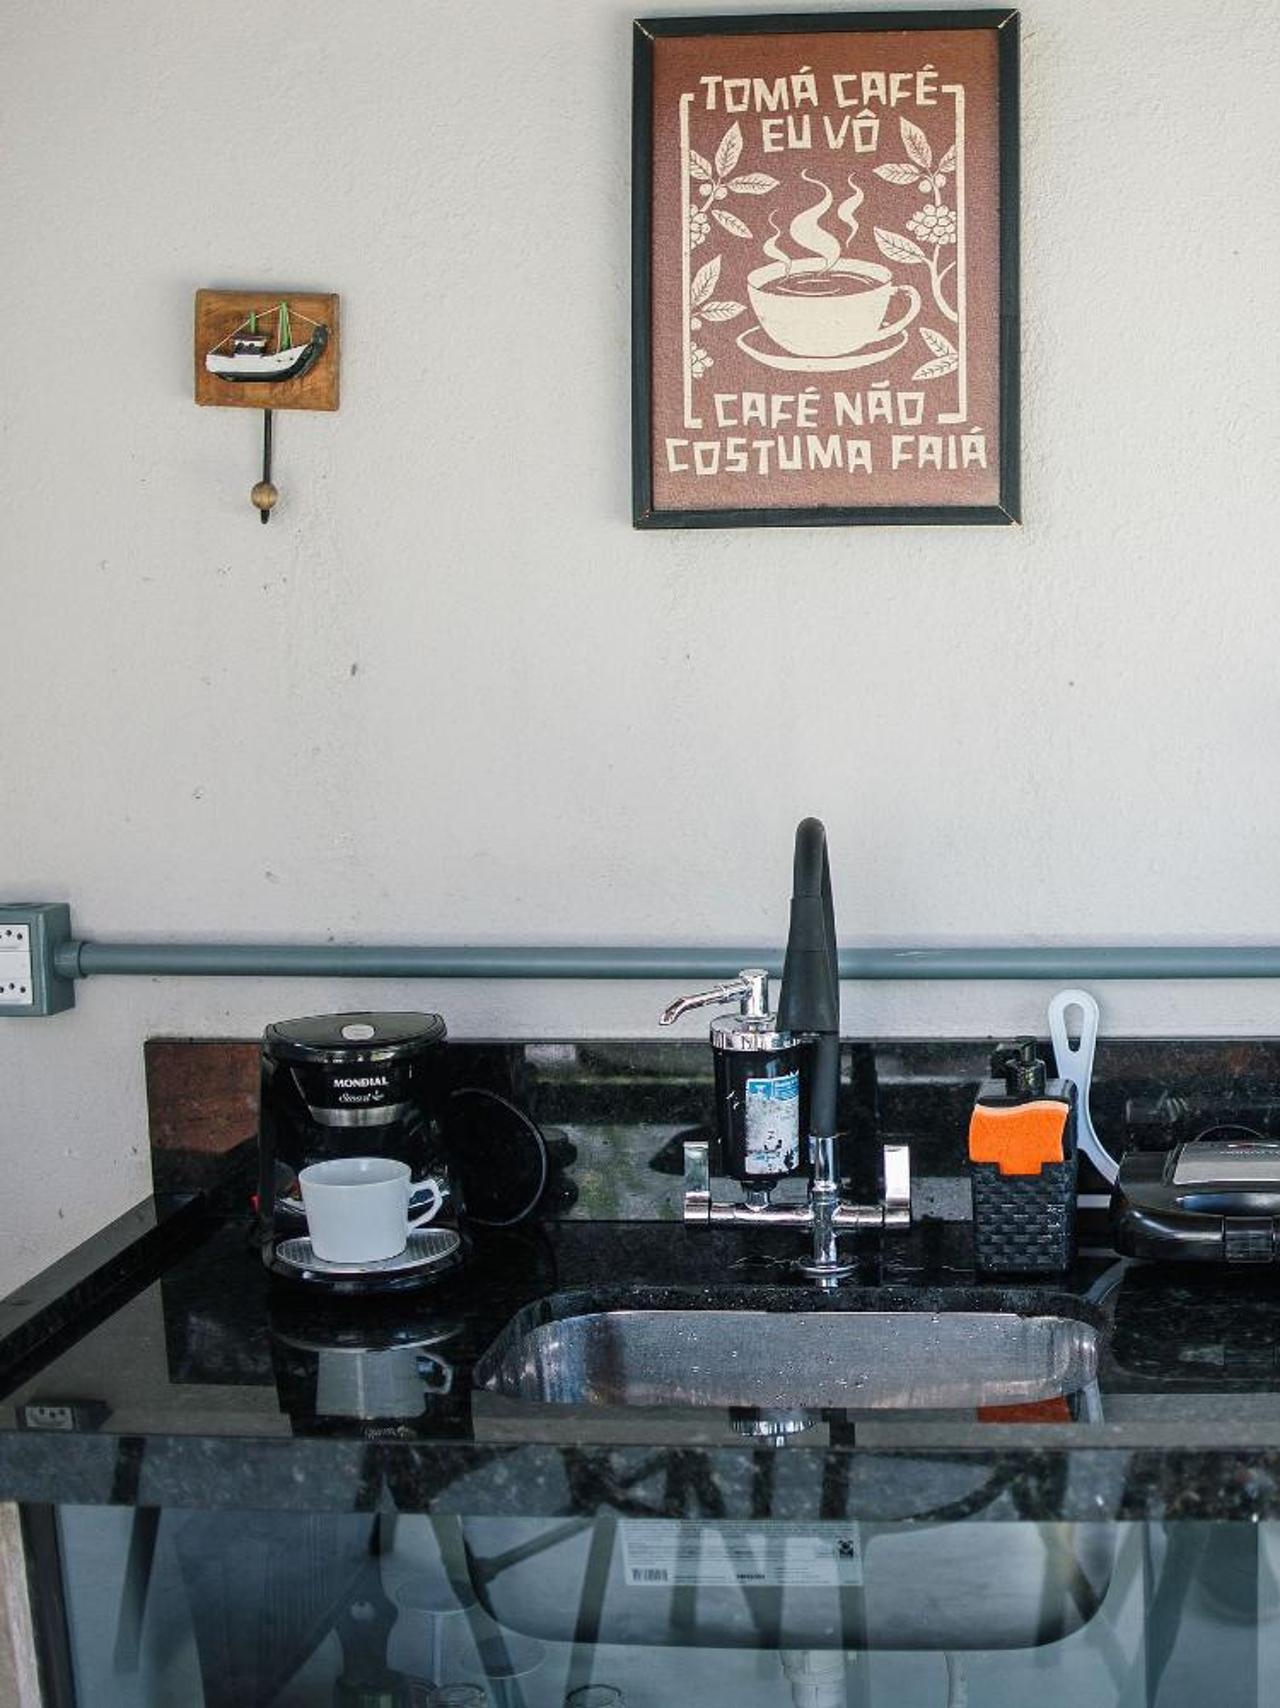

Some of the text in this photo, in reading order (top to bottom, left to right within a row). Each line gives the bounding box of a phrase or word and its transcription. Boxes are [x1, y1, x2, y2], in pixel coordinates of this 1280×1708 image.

[700, 64, 938, 113] TOMÁ CAFÉ
[761, 109, 880, 153] EU VÔ
[714, 380, 926, 429] CAFÉ NÃO
[665, 427, 988, 475] COSTUMA FAIÁ
[333, 1076, 390, 1088] MONDIAL
